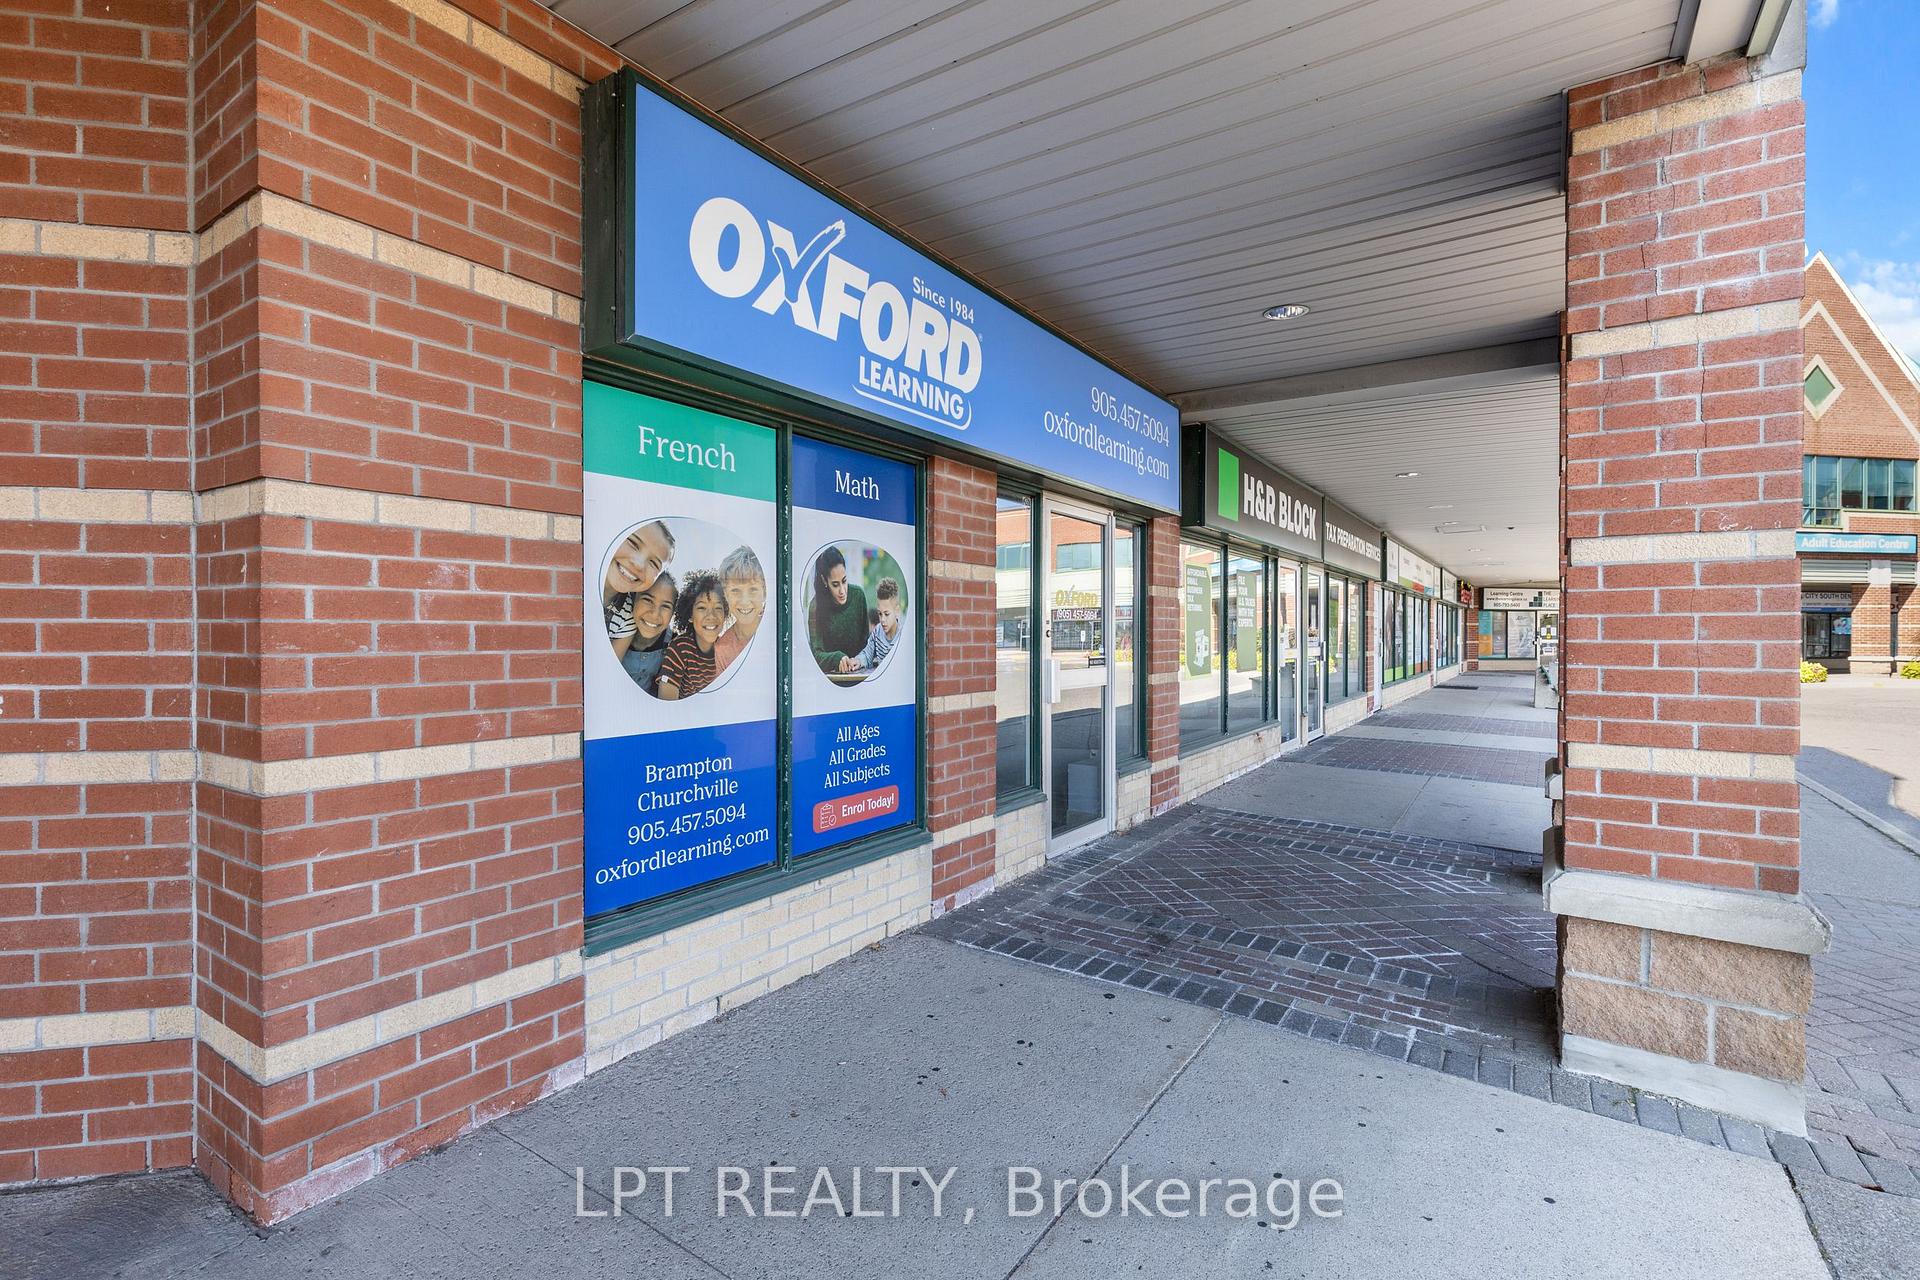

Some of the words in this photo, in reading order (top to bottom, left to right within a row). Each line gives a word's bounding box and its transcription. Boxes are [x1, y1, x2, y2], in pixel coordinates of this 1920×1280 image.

[689, 197, 983, 394] OXFORD
[912, 276, 946, 309] Since
[950, 297, 975, 324] 1984
[859, 355, 965, 420] LEARNING
[1091, 386, 1170, 448] 905.457.5094
[638, 425, 736, 472] French
[1043, 410, 1170, 480] oxfordlearning.com
[834, 470, 880, 501] Math
[1243, 472, 1276, 525] H&R
[1278, 490, 1317, 541] BLOCK
[1325, 521, 1337, 544] TAX
[1336, 527, 1366, 555] PREPARATION
[1801, 537, 1828, 548] Adult
[1830, 538, 1877, 549] Education
[1878, 538, 1910, 550] Centre
[1056, 589, 1098, 606] OXFORD
[1805, 592, 1818, 600] CITY
[1820, 592, 1839, 600] SOUTH
[836, 726, 852, 743] All
[853, 724, 880, 743] Ages
[645, 756, 733, 783] Brampton
[828, 748, 845, 766] All
[847, 744, 887, 763] Grades
[823, 771, 840, 789] All
[842, 763, 891, 784] Subjects
[637, 778, 739, 812] Churchville
[841, 801, 865, 817] Enrol
[866, 793, 895, 810] Today!
[627, 802, 747, 845] 905.457.5094
[595, 827, 769, 885] oxfordlearning.com
